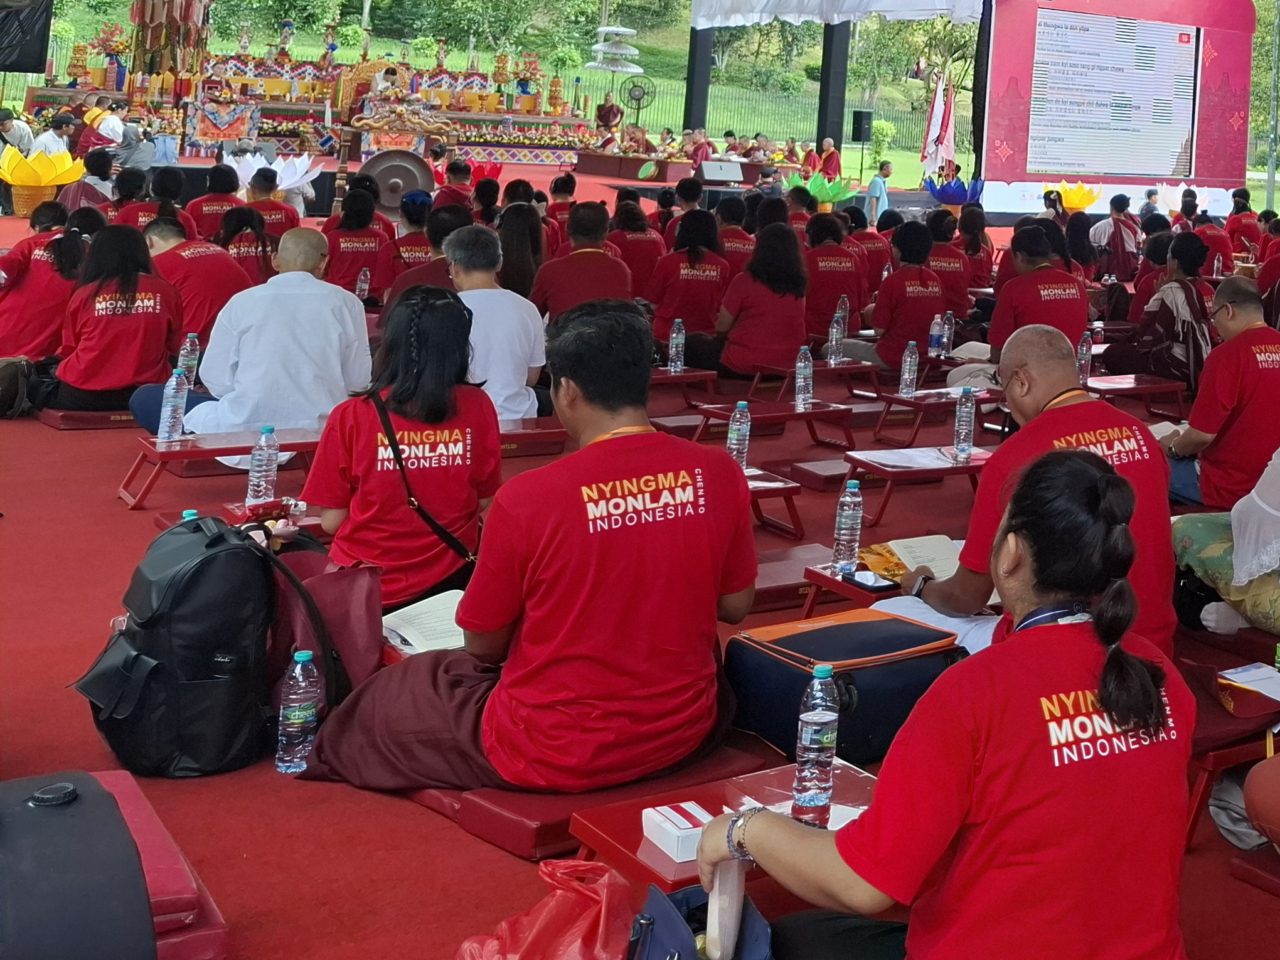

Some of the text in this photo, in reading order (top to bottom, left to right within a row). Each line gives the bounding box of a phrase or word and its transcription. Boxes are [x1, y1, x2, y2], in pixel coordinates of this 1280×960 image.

[680, 268, 717, 276] MONLAM
[1040, 288, 1076, 296] MONLAM
[377, 442, 464, 460] MONLAM
[1053, 426, 1133, 449] NYINGMA
[1104, 450, 1142, 465] NESIA
[580, 469, 693, 502] NYINGMA
[694, 468, 706, 514] CHENMO
[586, 485, 695, 520] MONLAM
[588, 503, 695, 534] INDONESIA
[1040, 689, 1102, 720] NYIN
[1160, 687, 1177, 740] HENMO
[1053, 727, 1168, 767] INDONESIA
